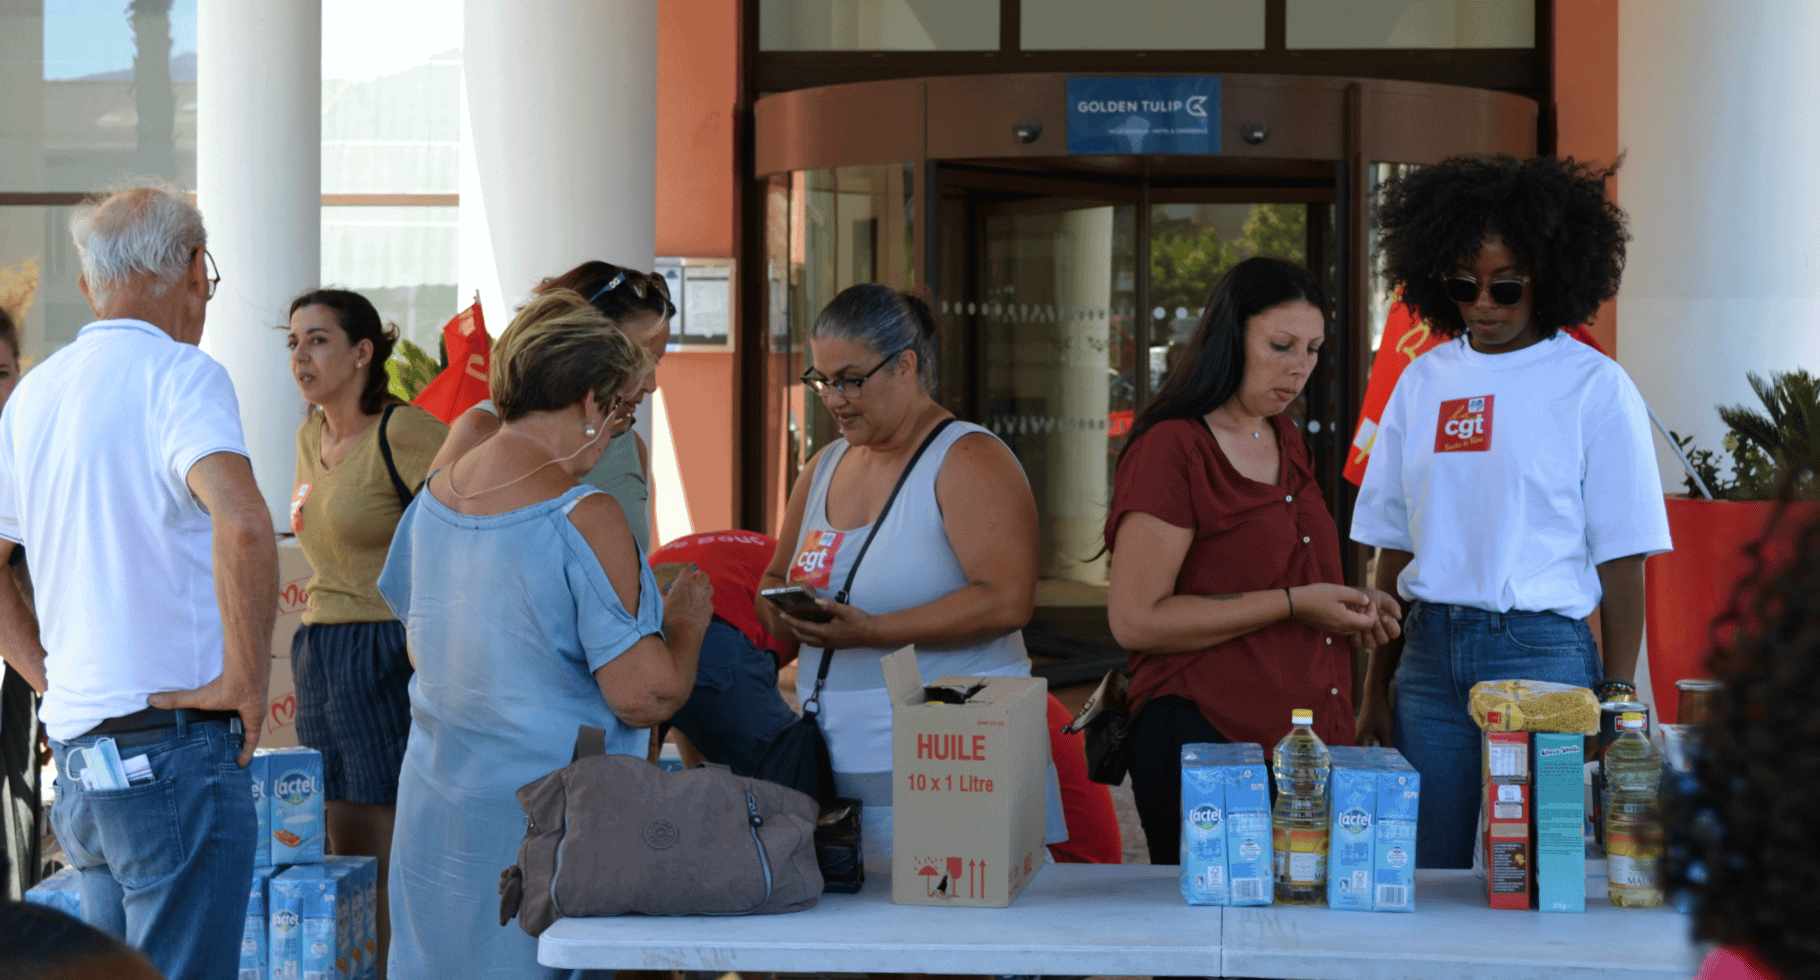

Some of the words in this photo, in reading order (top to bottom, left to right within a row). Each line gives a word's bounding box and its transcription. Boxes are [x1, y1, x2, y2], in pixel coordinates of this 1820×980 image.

[1077, 100, 1138, 113] GOLDEN
[1141, 100, 1183, 113] TULIP
[1445, 413, 1484, 439] cgt
[797, 548, 828, 572] cgt
[917, 733, 986, 761] HUILE
[274, 775, 318, 798] lactel
[908, 773, 927, 791] 10
[930, 777, 941, 791] x
[945, 774, 952, 792] 1
[959, 774, 994, 793] Litre
[1189, 808, 1223, 825] lactel
[1337, 812, 1373, 828] lactel
[272, 912, 300, 926] lactel
